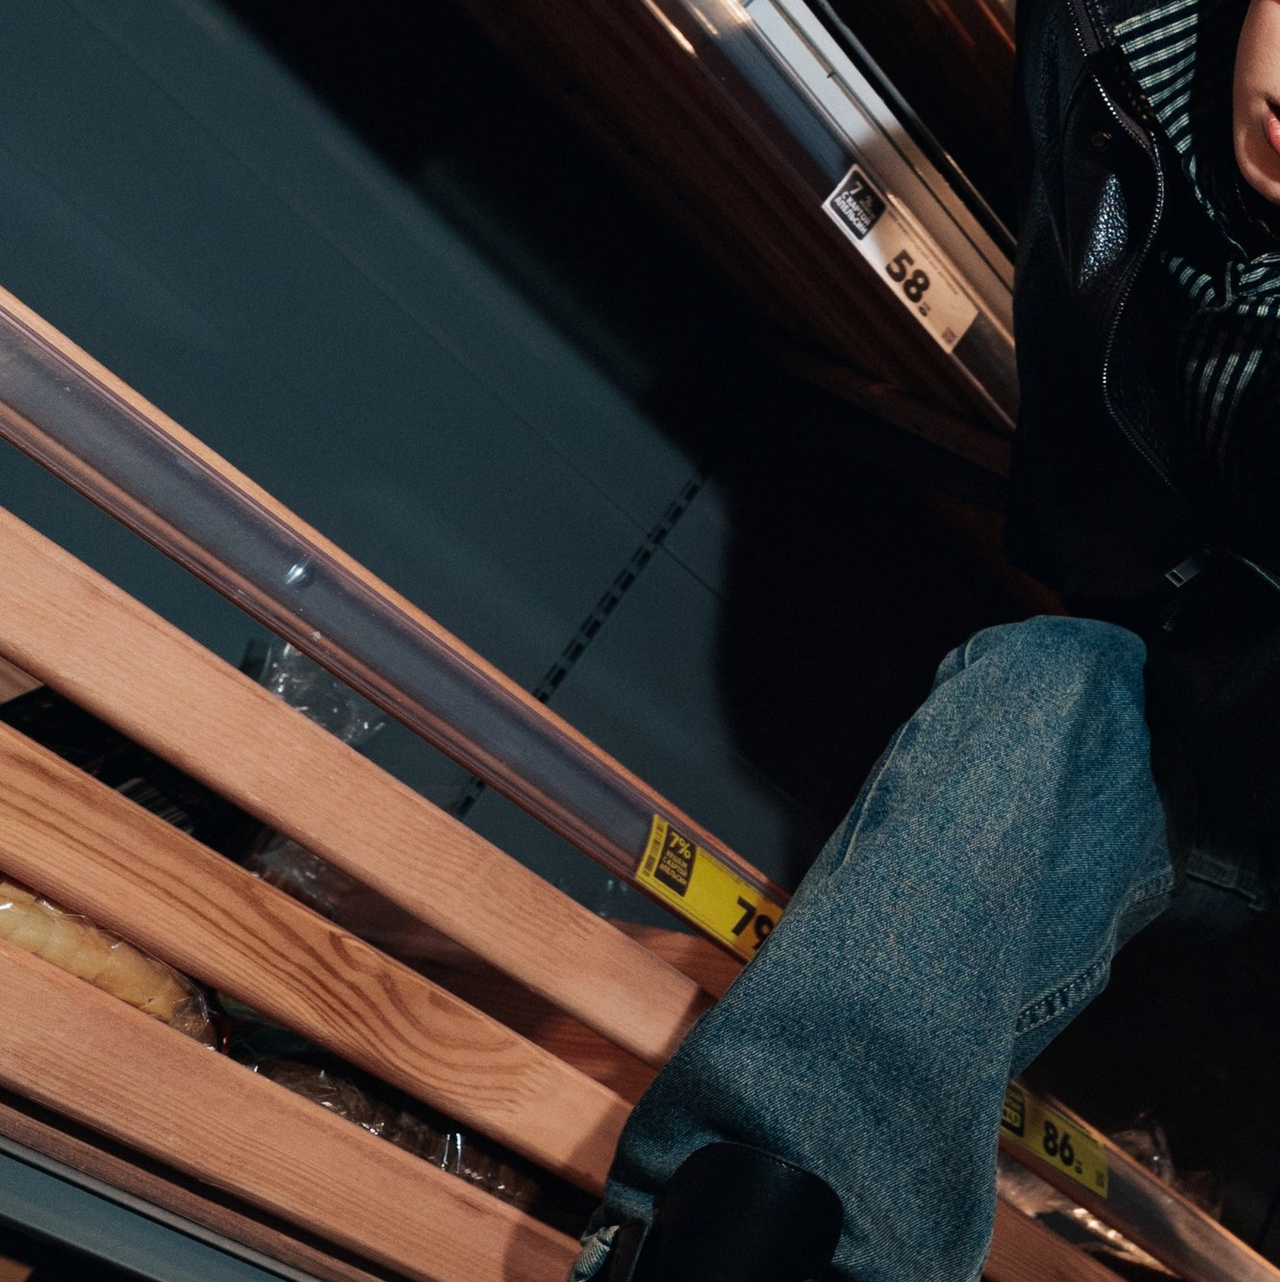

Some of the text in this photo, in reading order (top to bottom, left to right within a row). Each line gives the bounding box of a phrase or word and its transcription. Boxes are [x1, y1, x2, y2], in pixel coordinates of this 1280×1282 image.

[886, 249, 930, 303] 58
[670, 831, 692, 859] 7%
[731, 895, 775, 951] 79
[1042, 1119, 1075, 1167] 86
